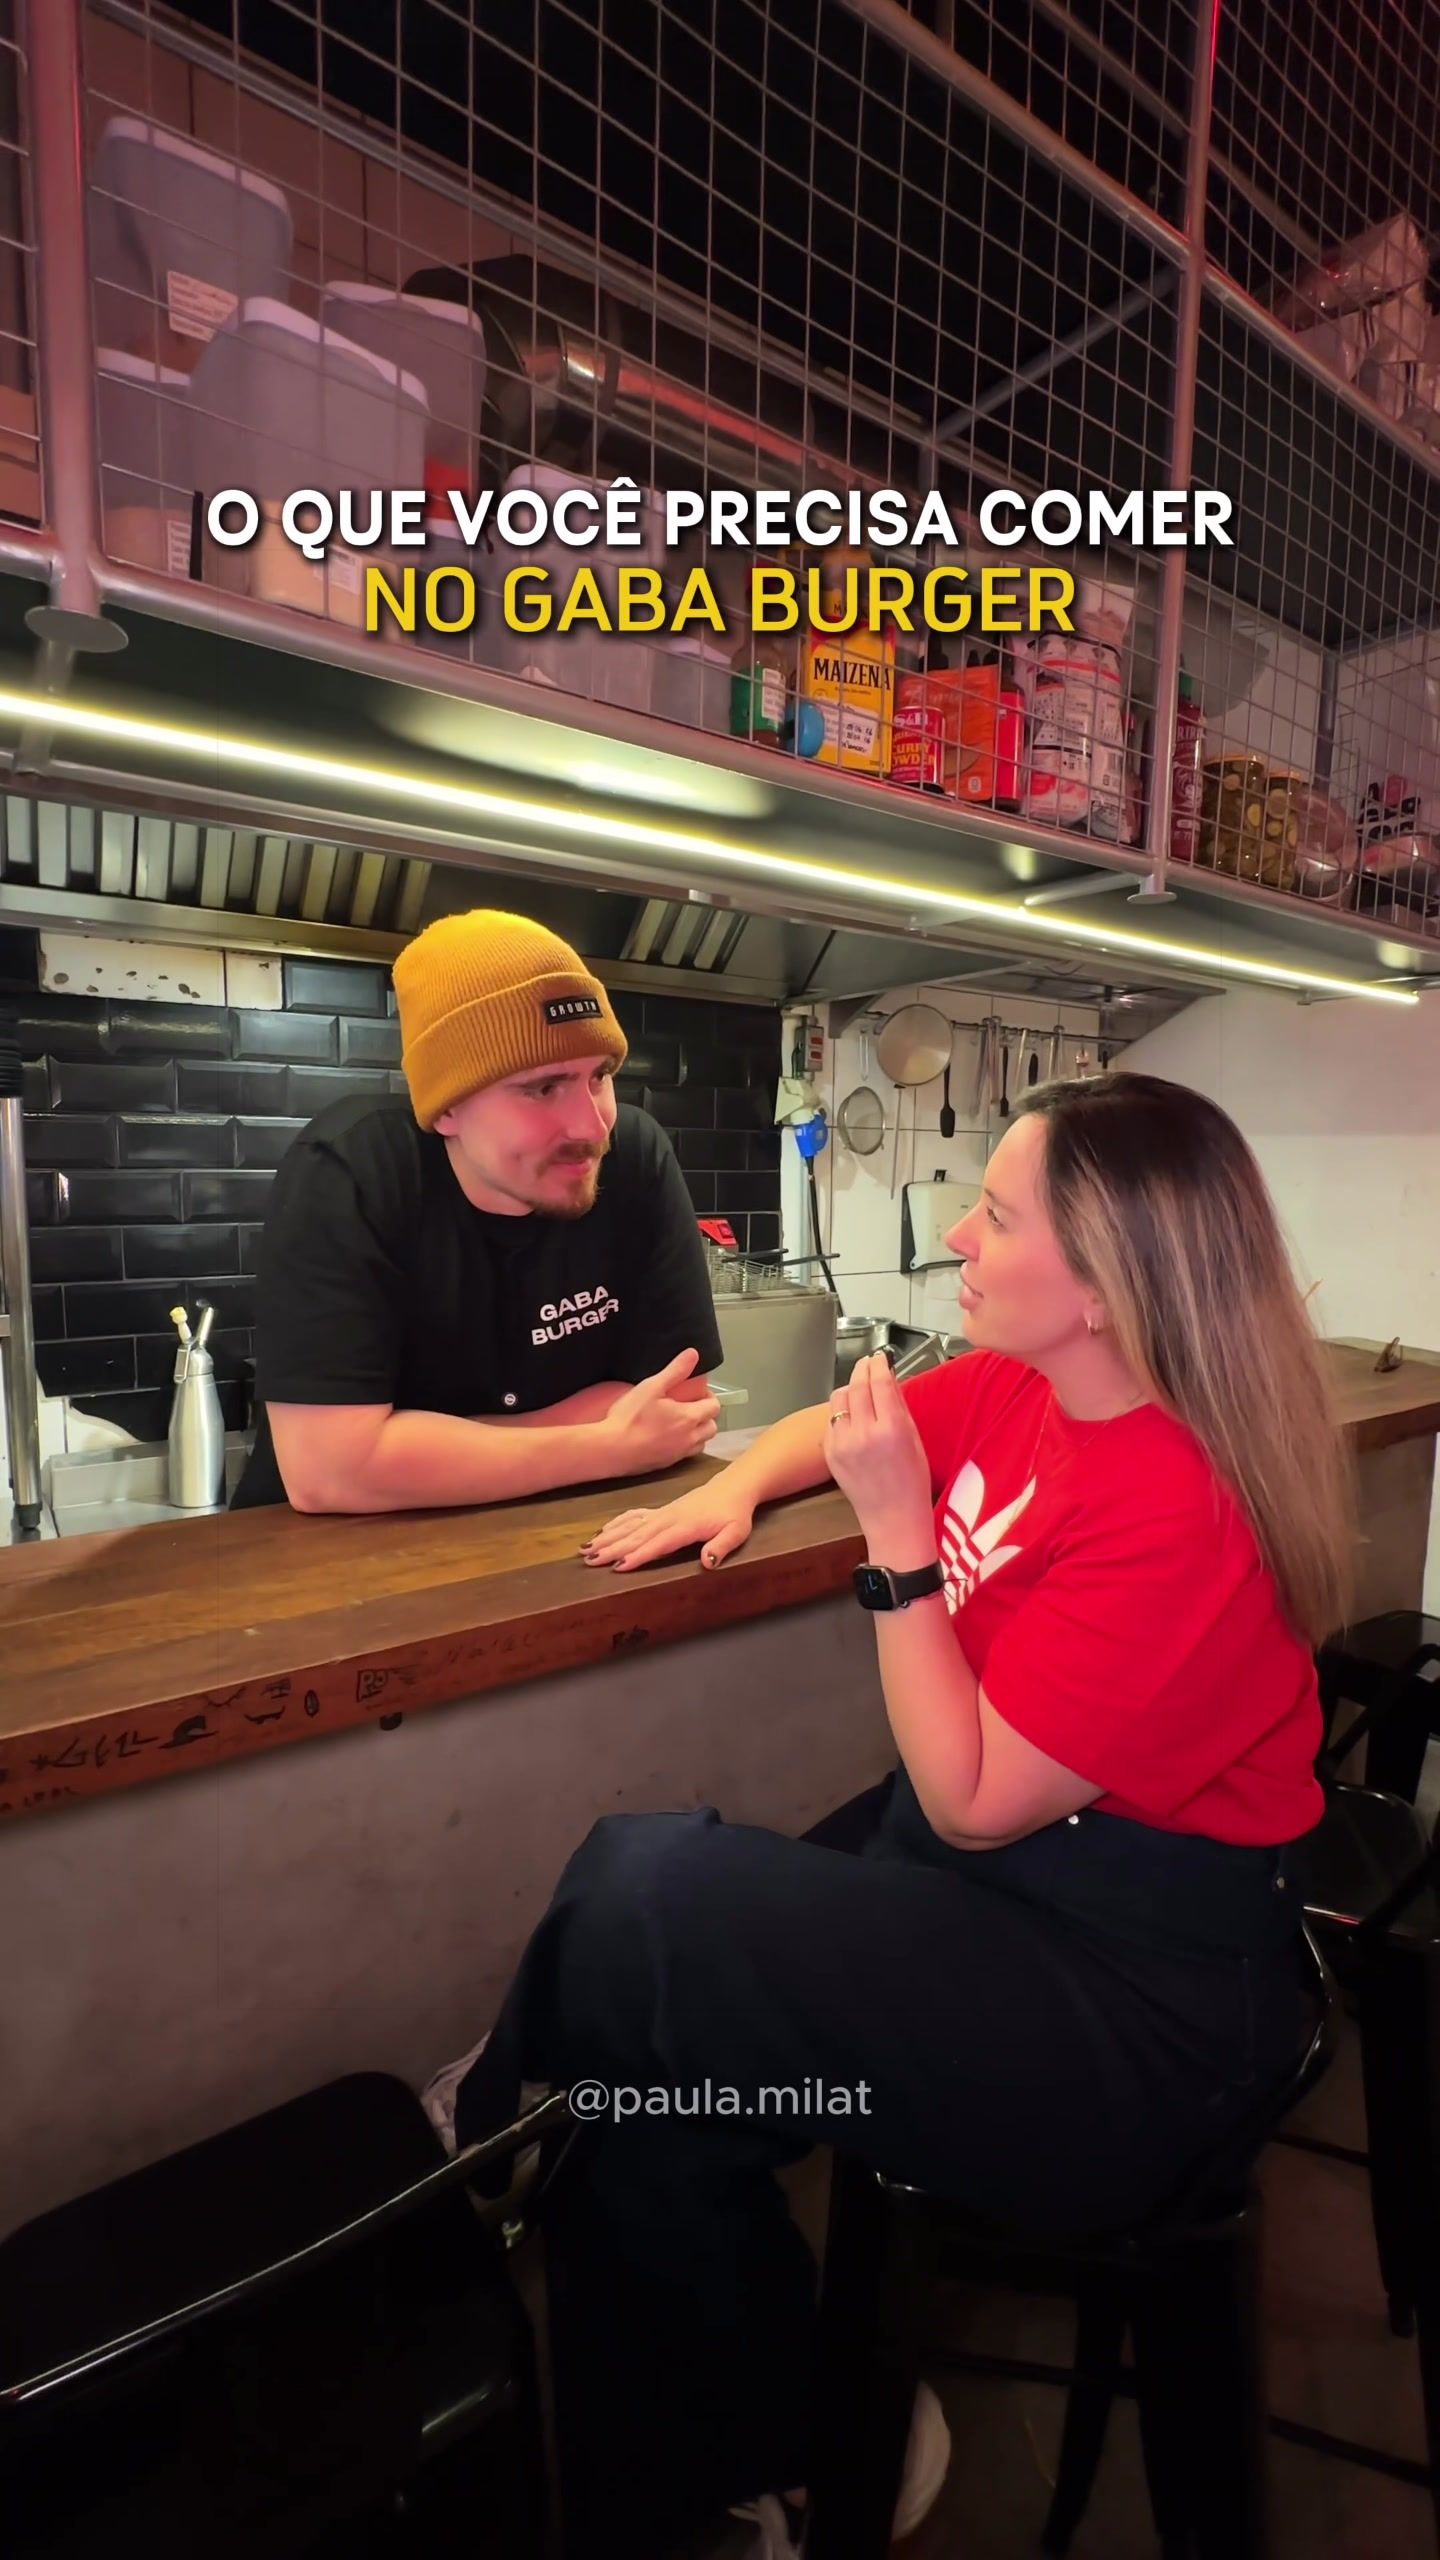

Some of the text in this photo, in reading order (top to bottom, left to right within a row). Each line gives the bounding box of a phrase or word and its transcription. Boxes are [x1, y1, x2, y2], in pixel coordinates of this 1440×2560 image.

[813, 657, 891, 690] MAIZENA
[531, 1298, 620, 1346] BURGER
[539, 1285, 609, 1322] GABA
